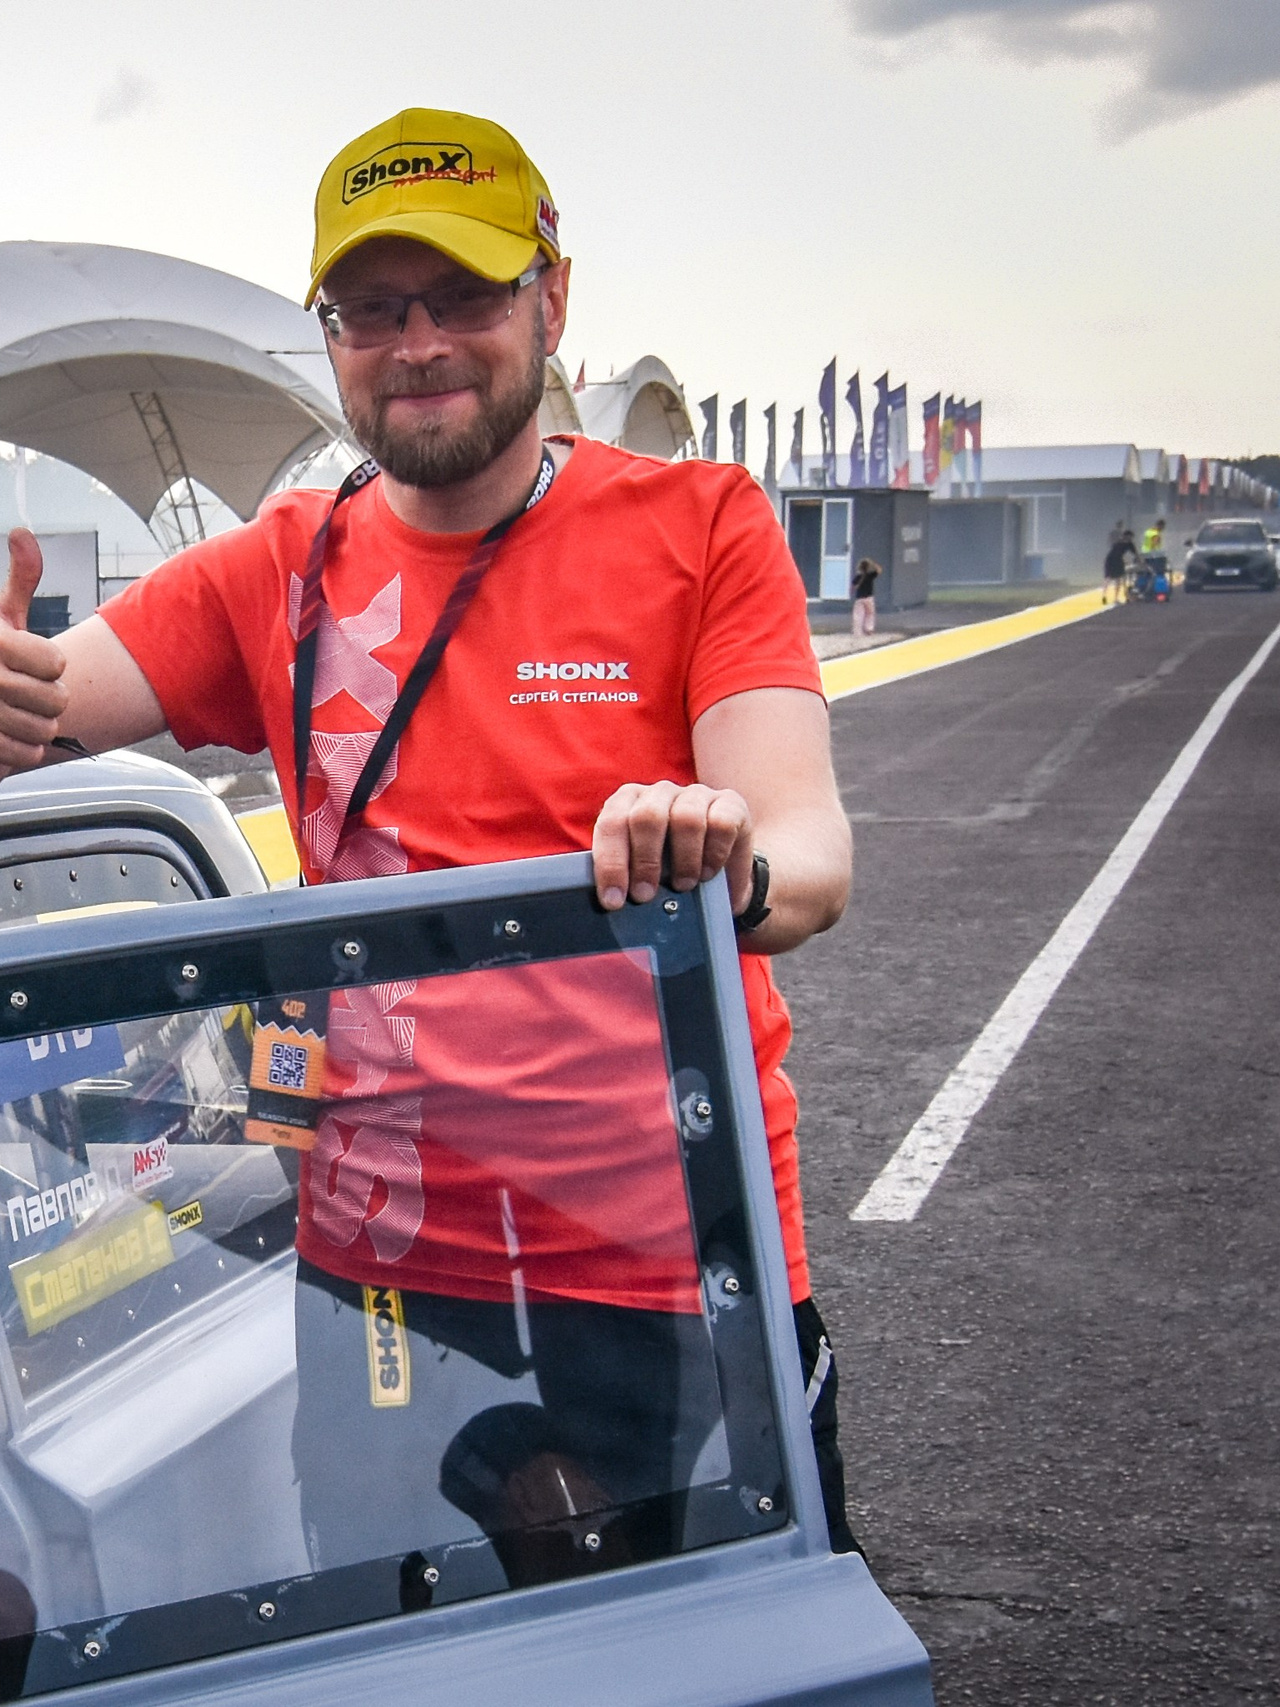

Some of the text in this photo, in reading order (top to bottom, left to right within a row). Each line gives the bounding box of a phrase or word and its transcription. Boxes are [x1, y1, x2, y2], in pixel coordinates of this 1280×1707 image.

[516, 662, 630, 681] SHONX
[509, 690, 639, 705] СЕРГЕЙ СТЕПАНОВ
[169, 1205, 202, 1231] SHONX
